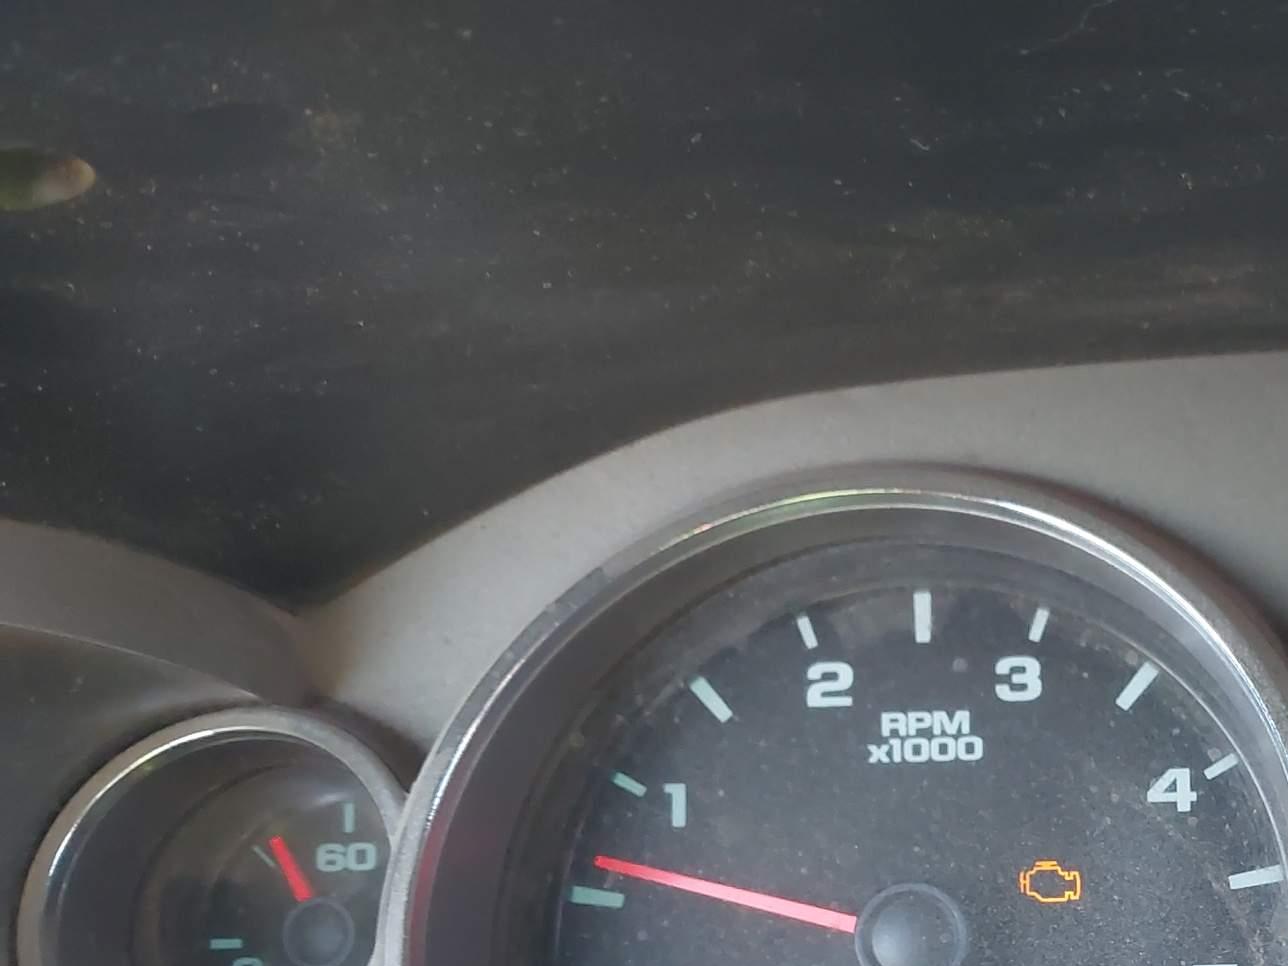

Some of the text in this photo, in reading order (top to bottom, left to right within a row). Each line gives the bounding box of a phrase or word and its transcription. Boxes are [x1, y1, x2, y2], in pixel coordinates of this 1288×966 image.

[807, 661, 853, 707] 2
[995, 656, 1042, 702] 3
[881, 710, 971, 737] RPM
[868, 736, 983, 764] x1000
[664, 783, 687, 828] 1
[1147, 768, 1197, 812] 4
[316, 842, 377, 871] 60
